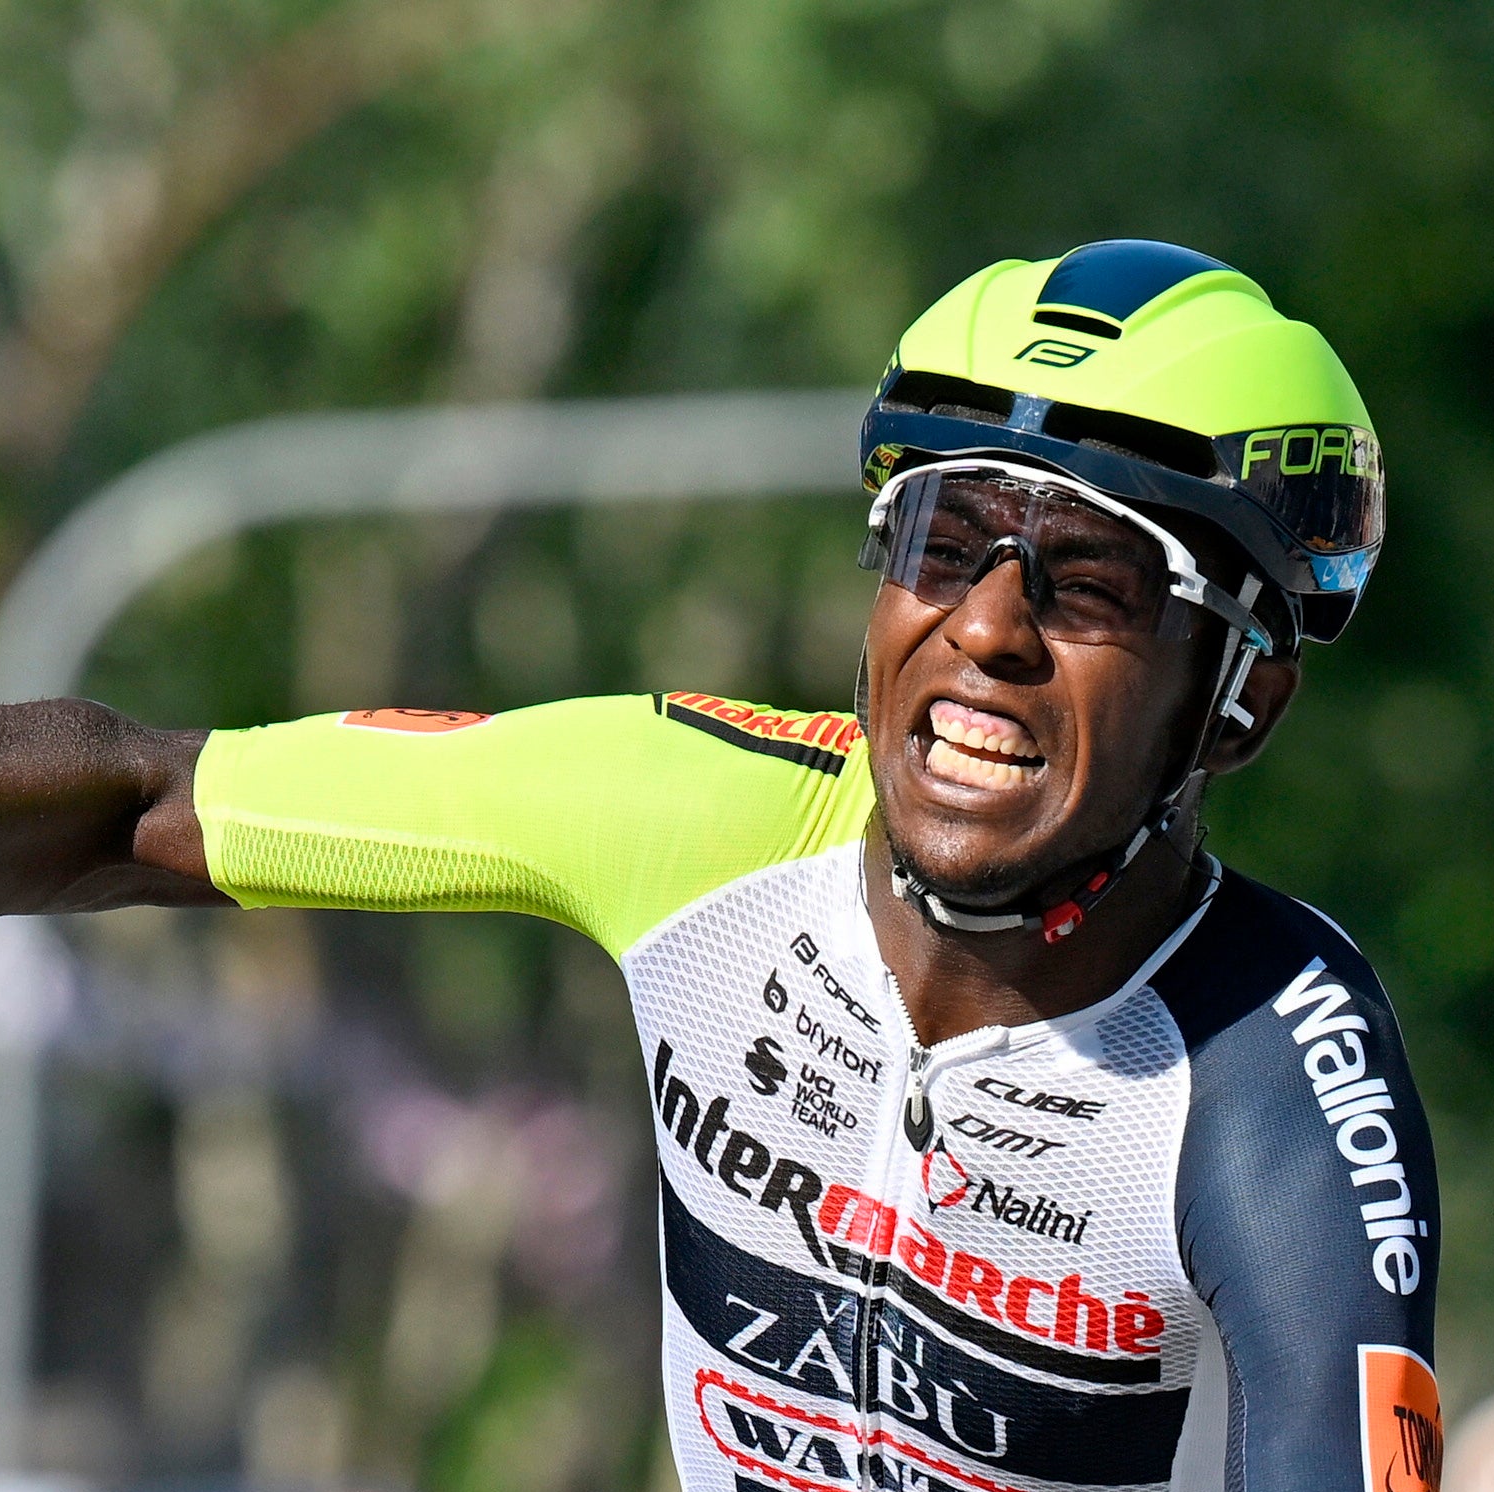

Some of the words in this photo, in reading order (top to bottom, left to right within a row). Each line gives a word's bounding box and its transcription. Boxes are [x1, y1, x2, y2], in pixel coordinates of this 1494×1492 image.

[796, 1004, 877, 1083] bryton
[791, 1098, 837, 1139] TEAM
[796, 1081, 857, 1129] WORLD
[973, 1077, 1107, 1121] CUBE
[948, 1113, 1067, 1158] DMT
[1272, 957, 1428, 1296] Wallonie
[970, 1178, 1093, 1246] Nalini
